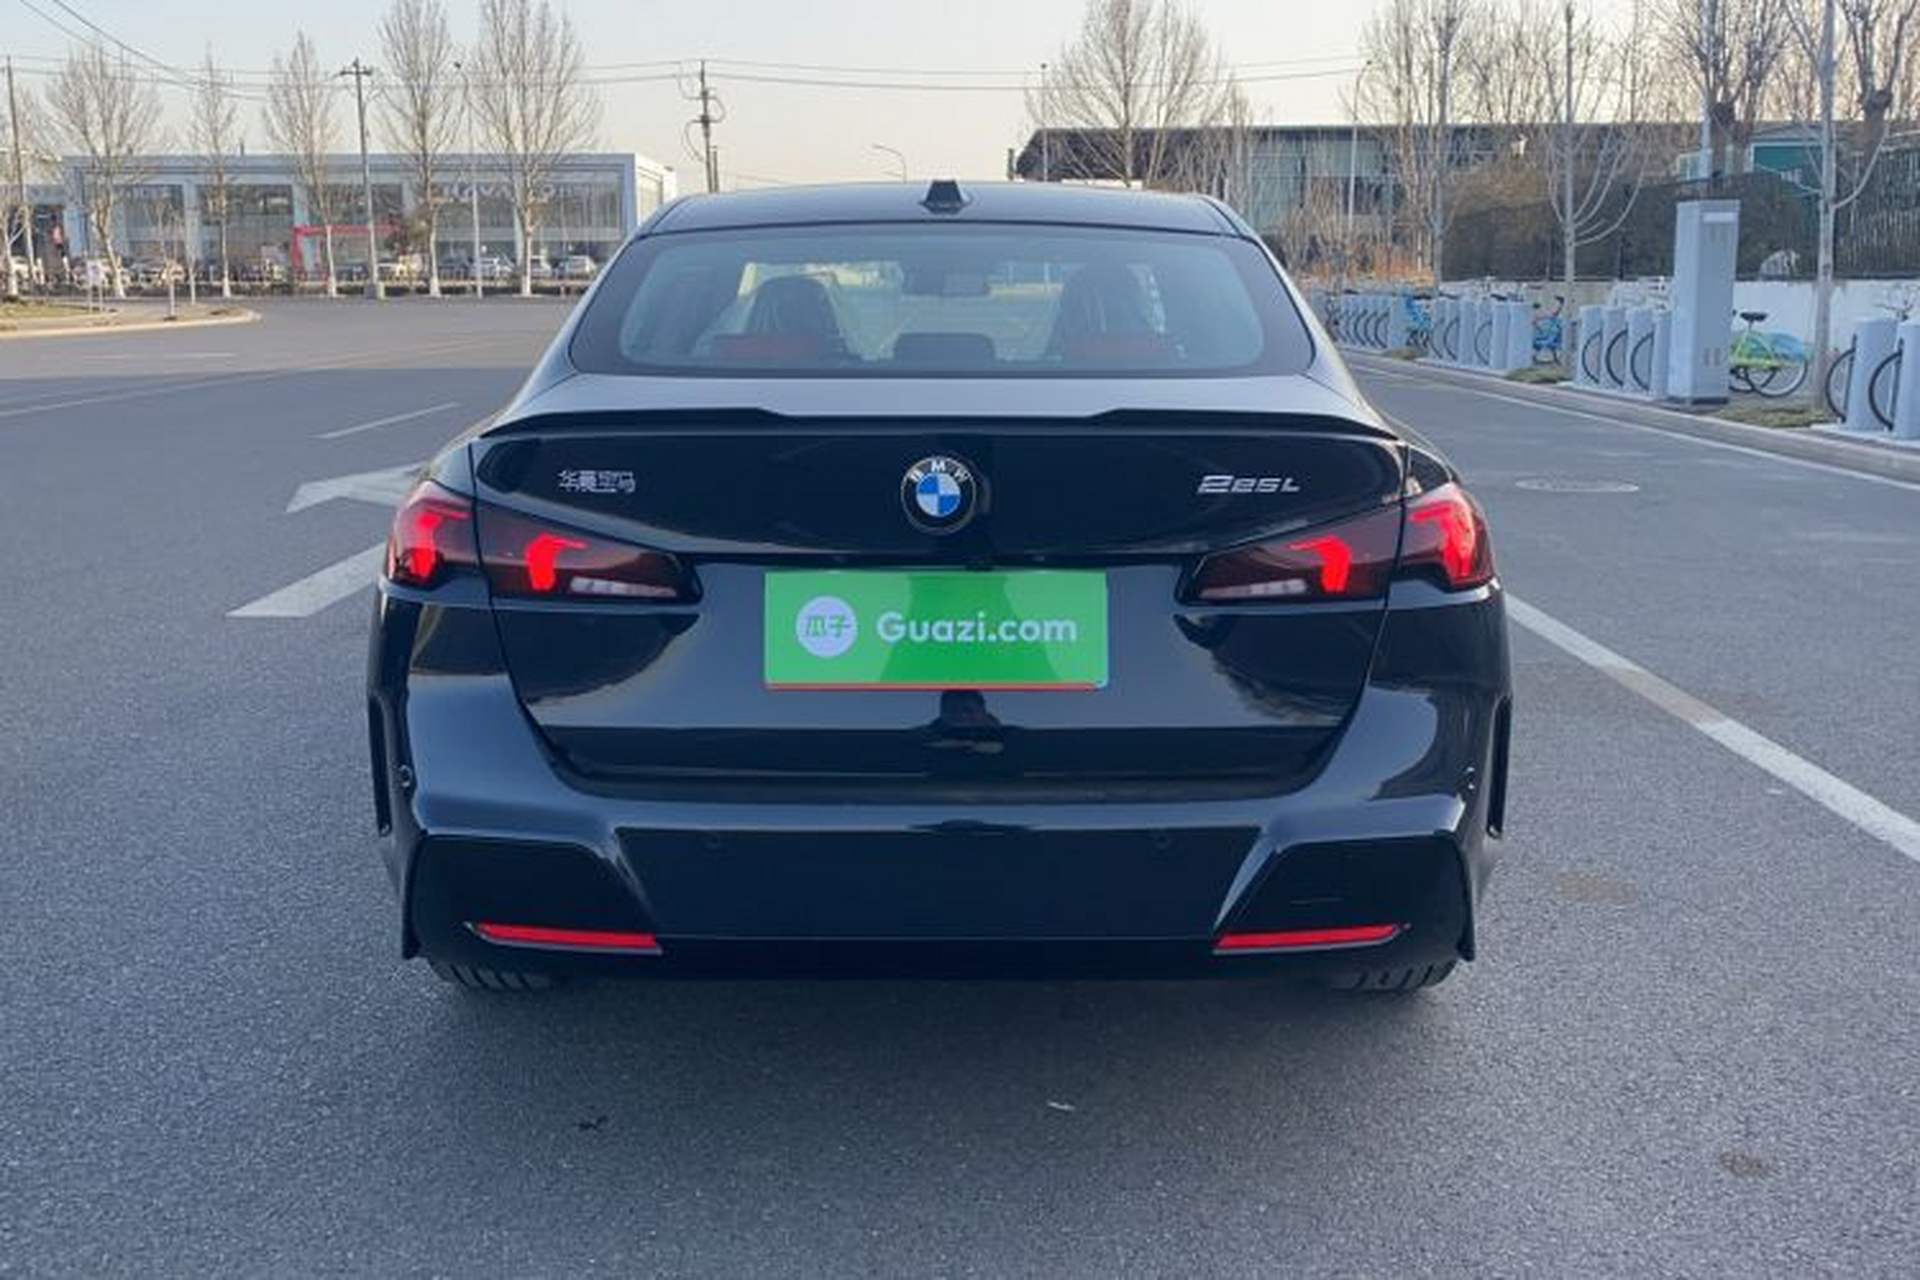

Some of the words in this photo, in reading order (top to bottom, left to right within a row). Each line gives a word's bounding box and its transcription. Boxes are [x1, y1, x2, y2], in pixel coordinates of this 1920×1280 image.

[909, 458, 973, 484] BMW
[800, 613, 853, 640] 瓜子
[876, 612, 1077, 643] Guazi.com
